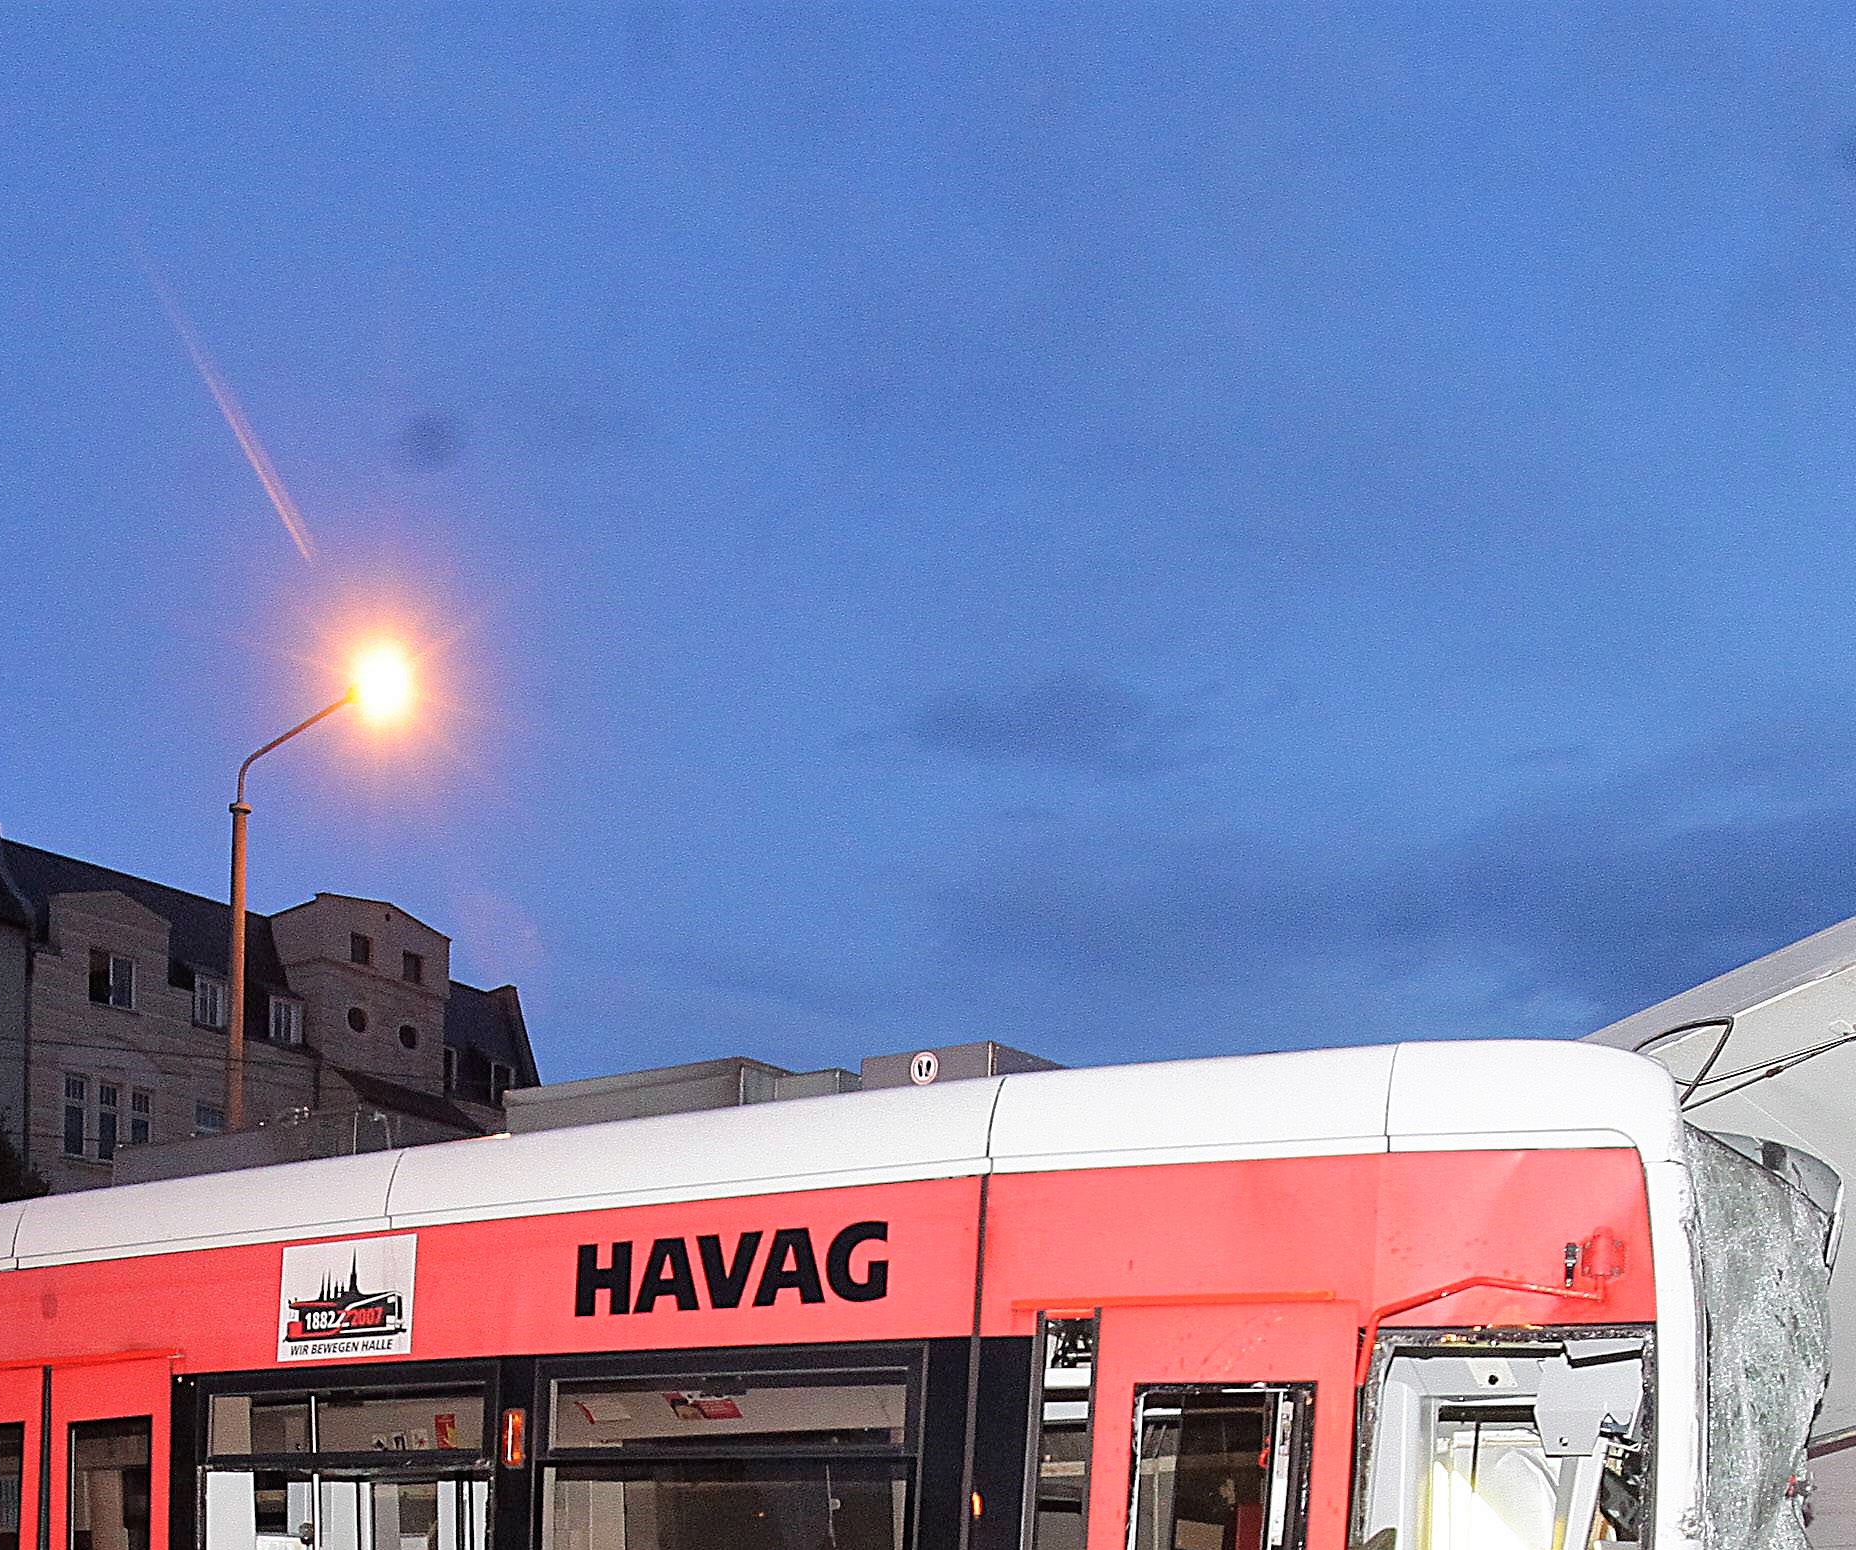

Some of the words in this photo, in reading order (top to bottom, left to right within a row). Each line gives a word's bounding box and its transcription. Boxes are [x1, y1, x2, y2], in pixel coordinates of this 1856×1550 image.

[575, 1221, 888, 1317] HAVAG
[305, 1311, 338, 1330] 1882
[350, 1307, 384, 1326] 2007
[290, 1344, 309, 1356] WIR
[311, 1341, 359, 1354] BEWEGEN
[362, 1338, 393, 1351] HALLE
